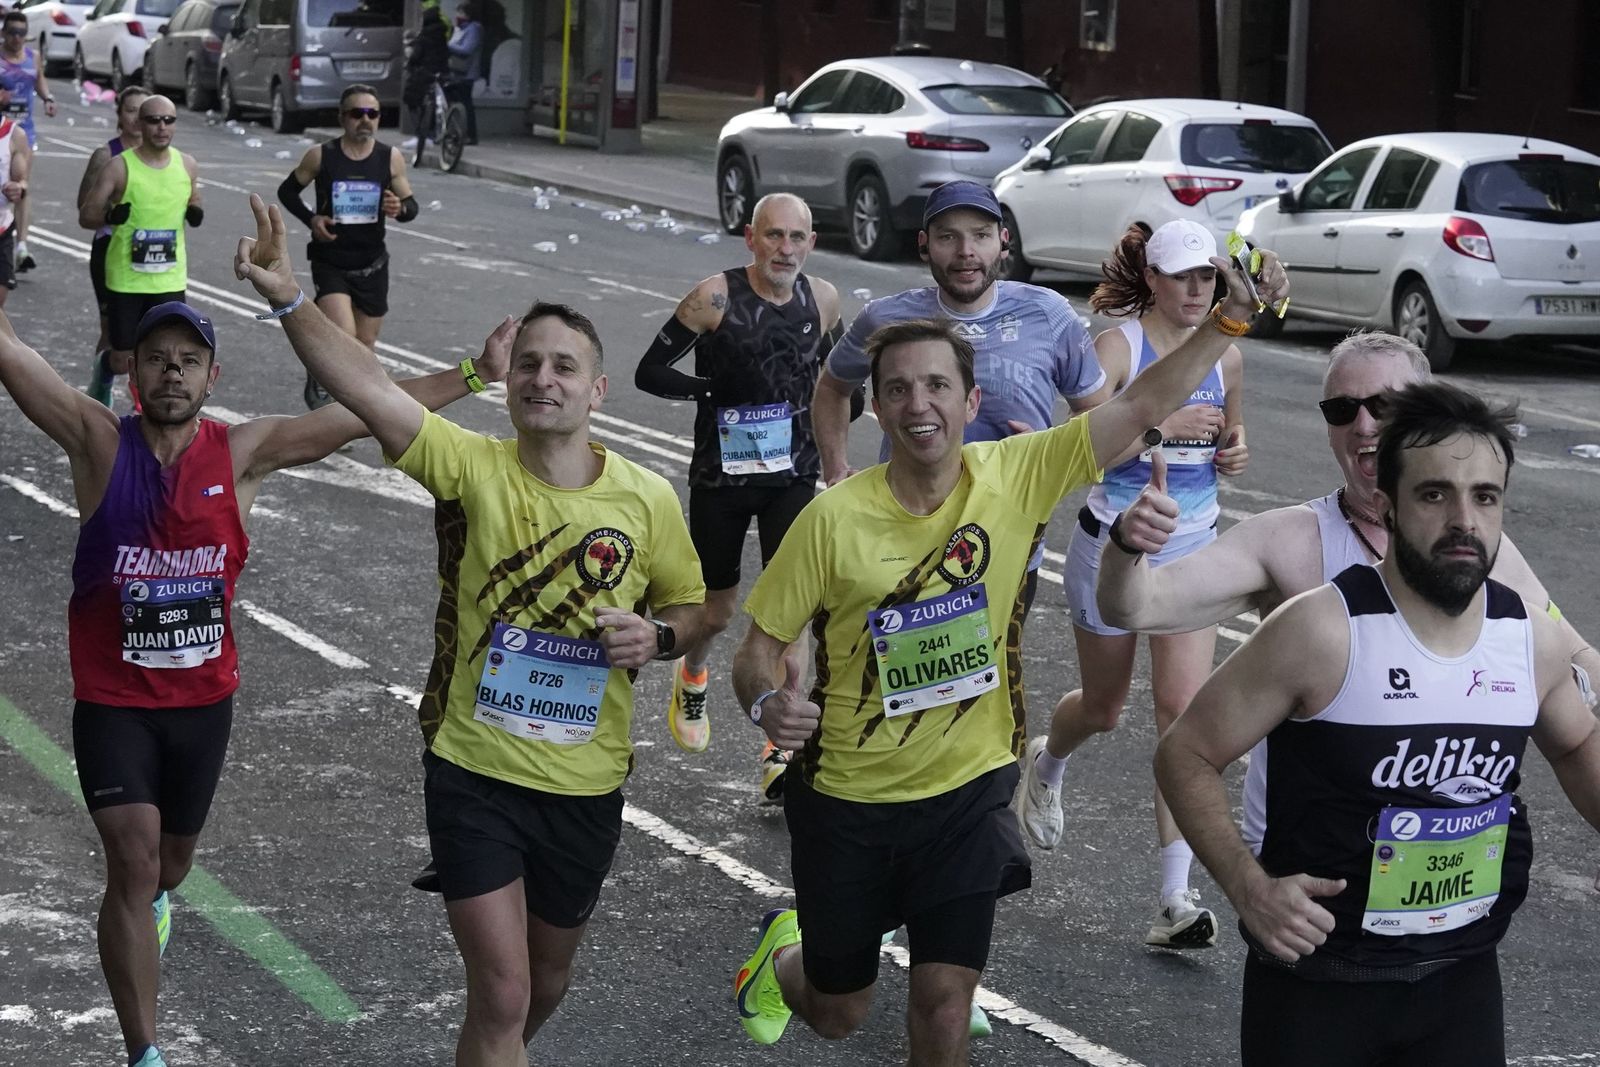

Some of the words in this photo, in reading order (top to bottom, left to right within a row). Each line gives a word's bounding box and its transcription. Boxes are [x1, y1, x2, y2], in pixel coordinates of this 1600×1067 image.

[1543, 299, 1577, 313] 7531
[744, 407, 785, 420] ZURICH
[747, 430, 769, 440] 8082
[113, 544, 228, 578] TEAMMORA
[156, 581, 213, 597] ZURICH
[159, 609, 189, 624] 5293
[911, 593, 974, 623] ZURICH
[122, 632, 169, 648] JUAN
[174, 623, 225, 648] DAVID
[918, 633, 951, 655] 2441
[534, 638, 600, 660] ZURICH
[886, 643, 989, 690] OLIVARES
[528, 670, 564, 688] 8726
[1491, 685, 1517, 693] DELIKIA
[479, 686, 525, 712] BLAS
[528, 698, 598, 723] HORNOS
[1430, 806, 1497, 834] ZURICH
[1426, 851, 1465, 872] 3346
[1401, 869, 1474, 906] JAIME
